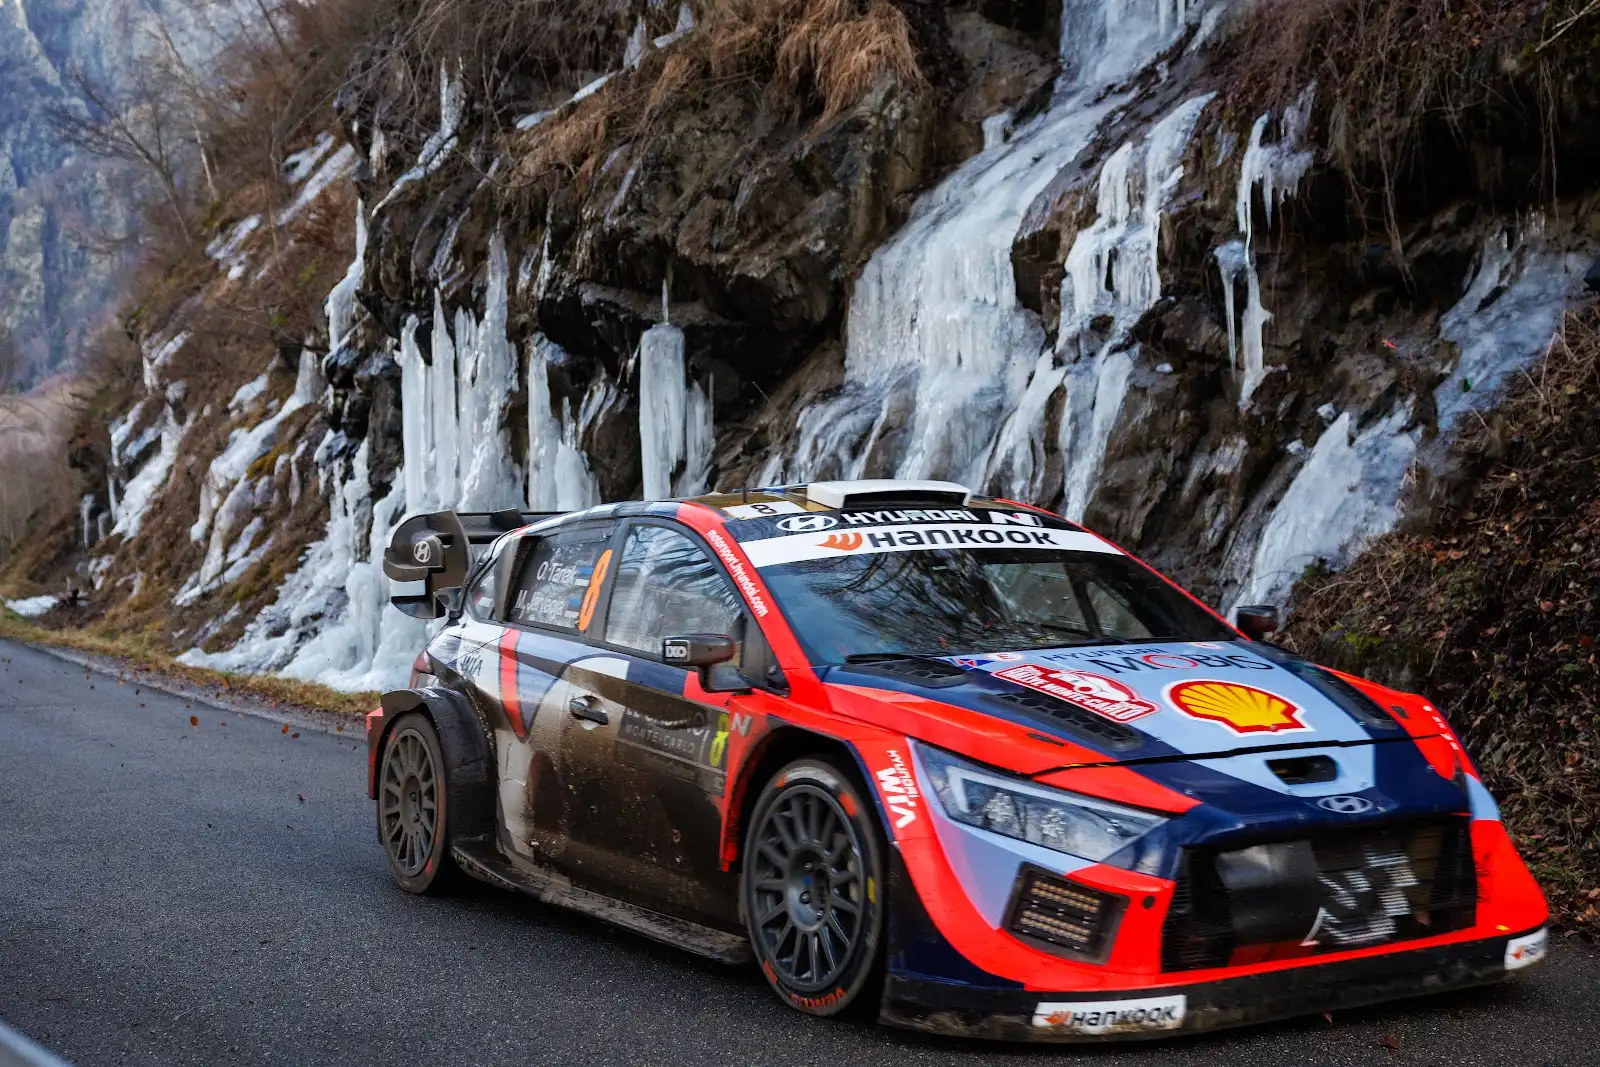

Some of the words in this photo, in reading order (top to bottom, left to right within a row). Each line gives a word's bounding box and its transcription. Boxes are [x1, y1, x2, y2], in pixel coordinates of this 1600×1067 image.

[751, 503, 778, 515] 8
[841, 508, 981, 525] HYUNDAI
[578, 548, 614, 631] 8
[706, 528, 769, 618] motorsport.hyundai.com
[1085, 653, 1274, 674] MOBIS
[730, 712, 753, 737] N
[886, 749, 921, 798] HYUNDAI
[875, 767, 917, 829] WIA
